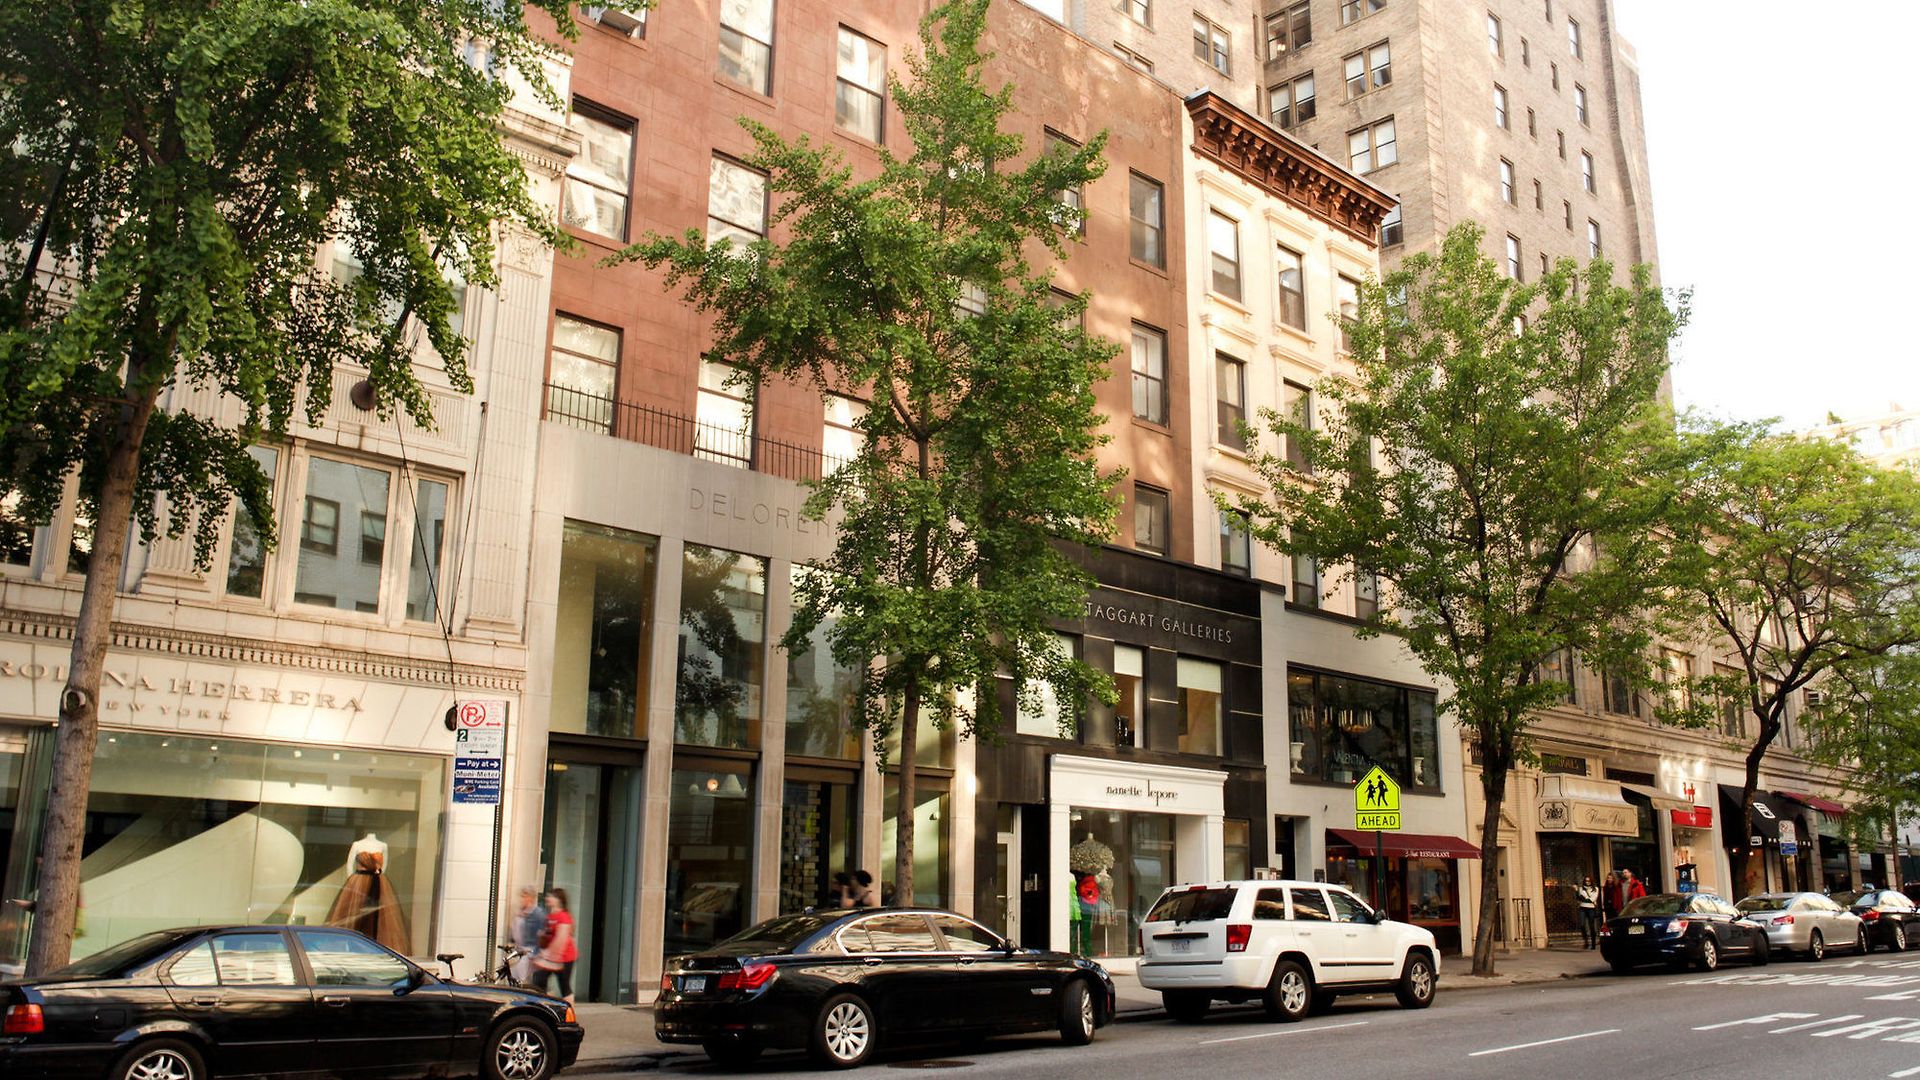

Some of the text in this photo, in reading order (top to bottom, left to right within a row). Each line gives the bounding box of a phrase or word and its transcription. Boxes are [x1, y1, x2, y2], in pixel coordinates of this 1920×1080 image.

[1086, 601, 1232, 644] TAGGART GALLERIES
[0, 660, 364, 713] ROLNA HERRERA
[105, 700, 232, 721] EW YORK
[459, 730, 467, 741] 2
[466, 760, 480, 768] Pay
[1106, 779, 1178, 807] nanette lepore
[1361, 816, 1396, 826] AHEAD
